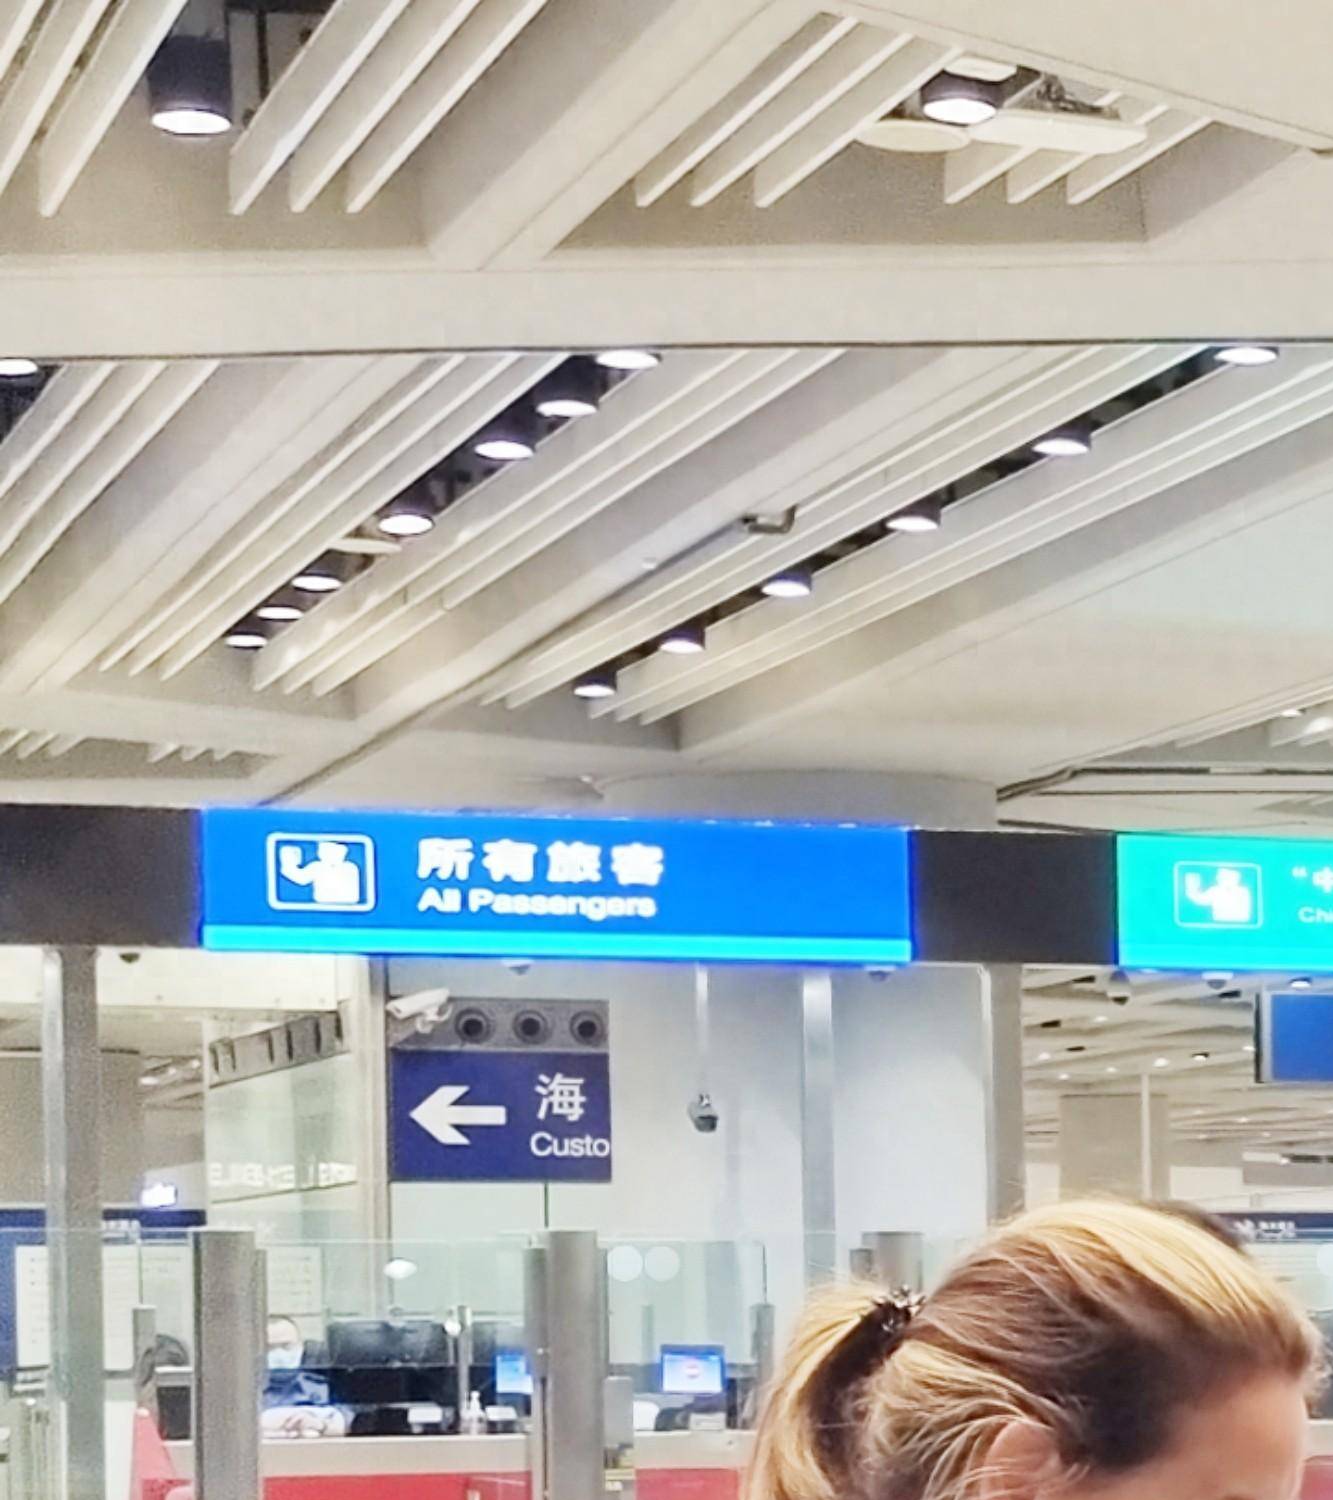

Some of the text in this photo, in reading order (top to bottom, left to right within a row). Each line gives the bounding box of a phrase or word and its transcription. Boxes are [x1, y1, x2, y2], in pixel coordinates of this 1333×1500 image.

[418, 837, 664, 886] 所有旅客
[417, 887, 657, 921] All Passengers
[535, 1073, 587, 1121] 海
[530, 1131, 610, 1157] Custo
